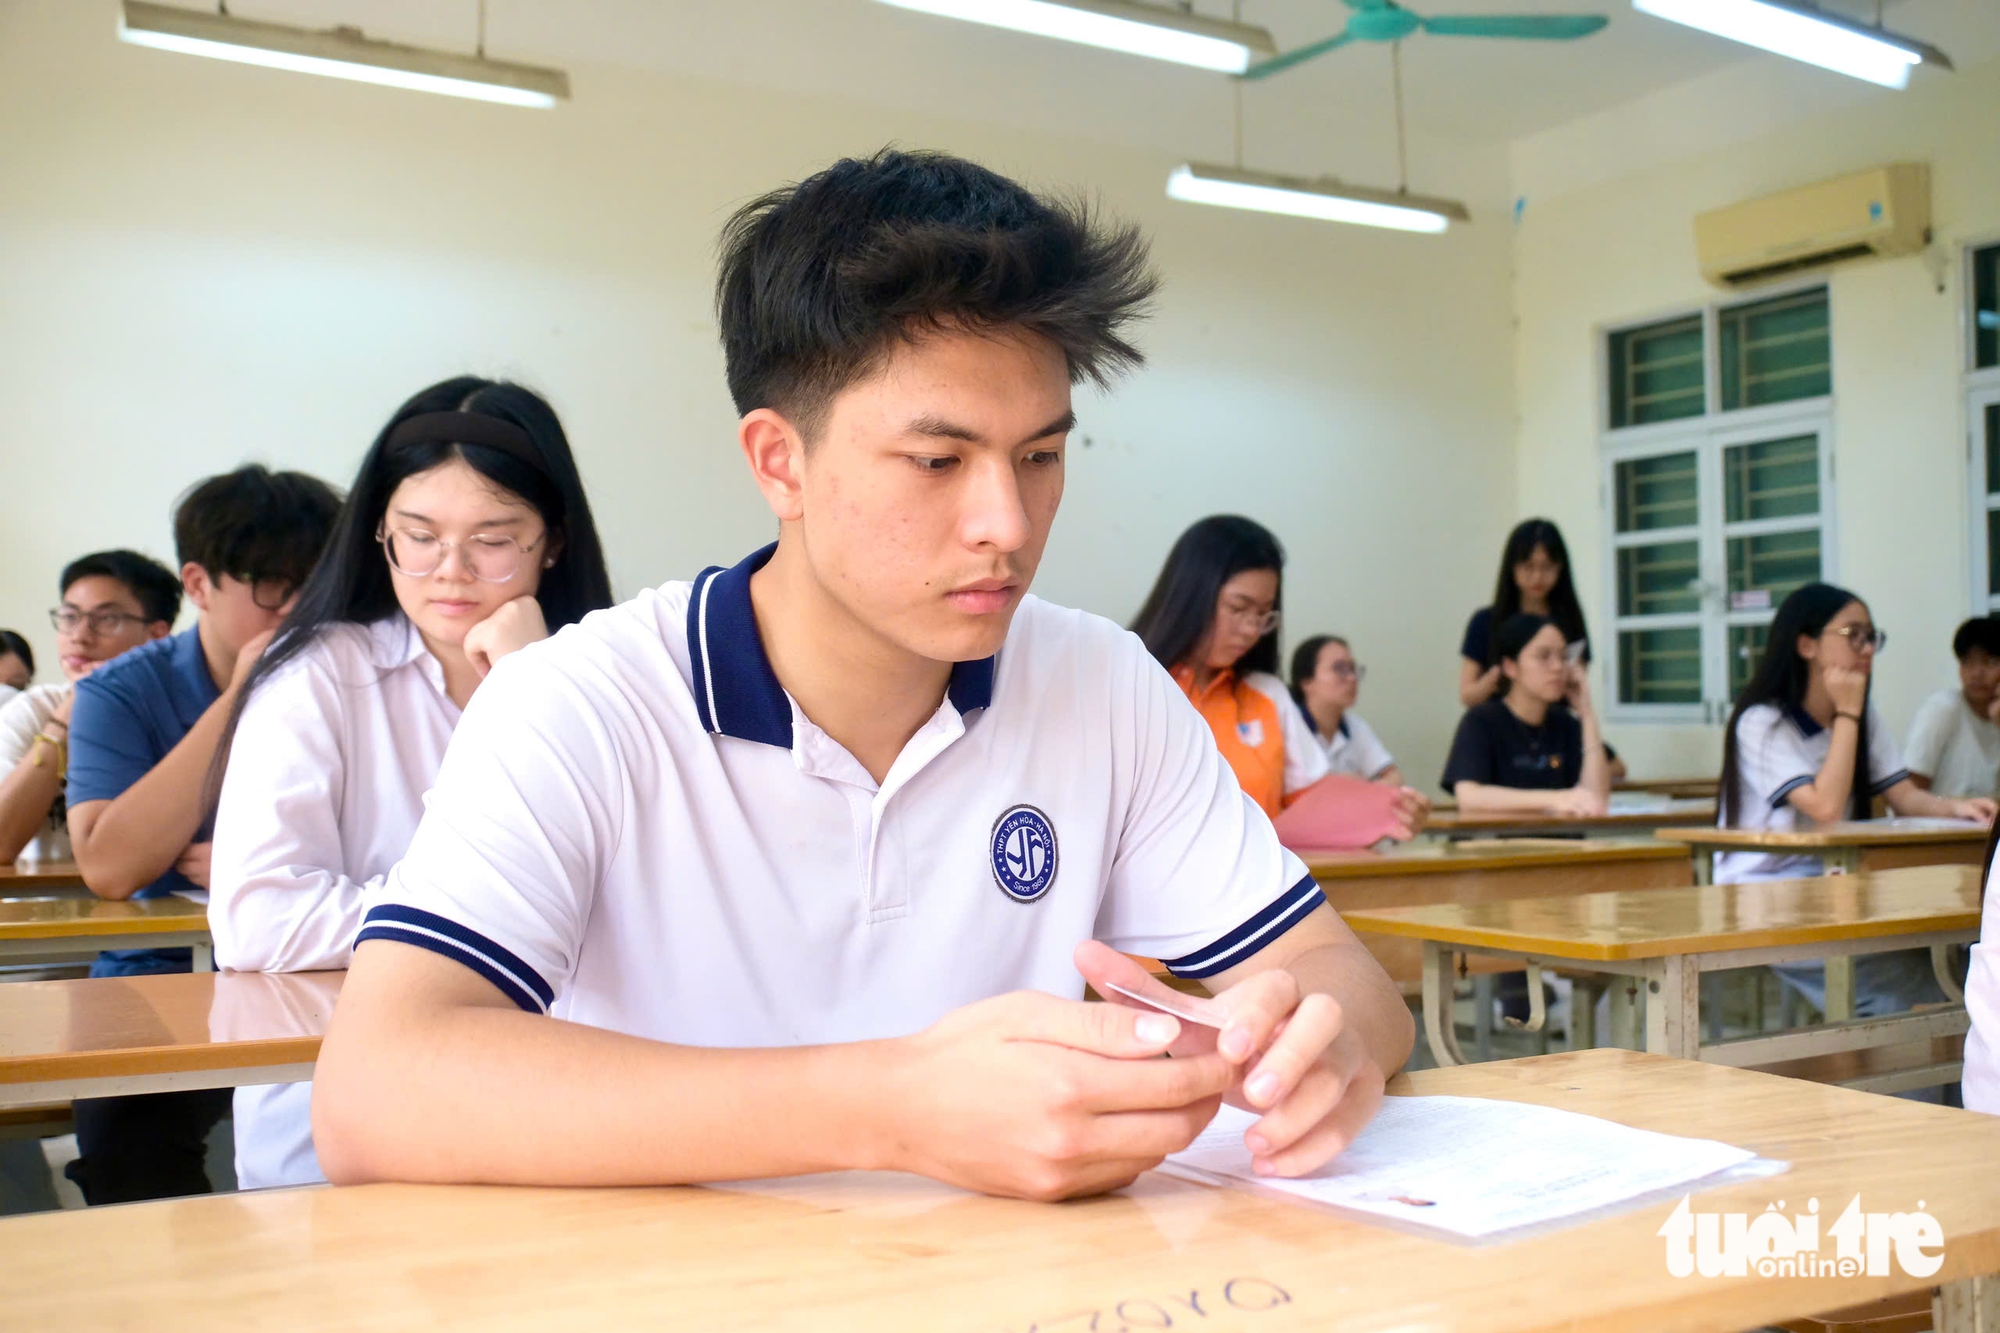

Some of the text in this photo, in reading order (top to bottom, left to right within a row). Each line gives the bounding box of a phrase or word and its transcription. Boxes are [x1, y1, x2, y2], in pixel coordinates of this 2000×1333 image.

[997, 833, 1007, 854] THPT
[1005, 820, 1019, 833] YÊN
[1013, 881, 1031, 893] Since
